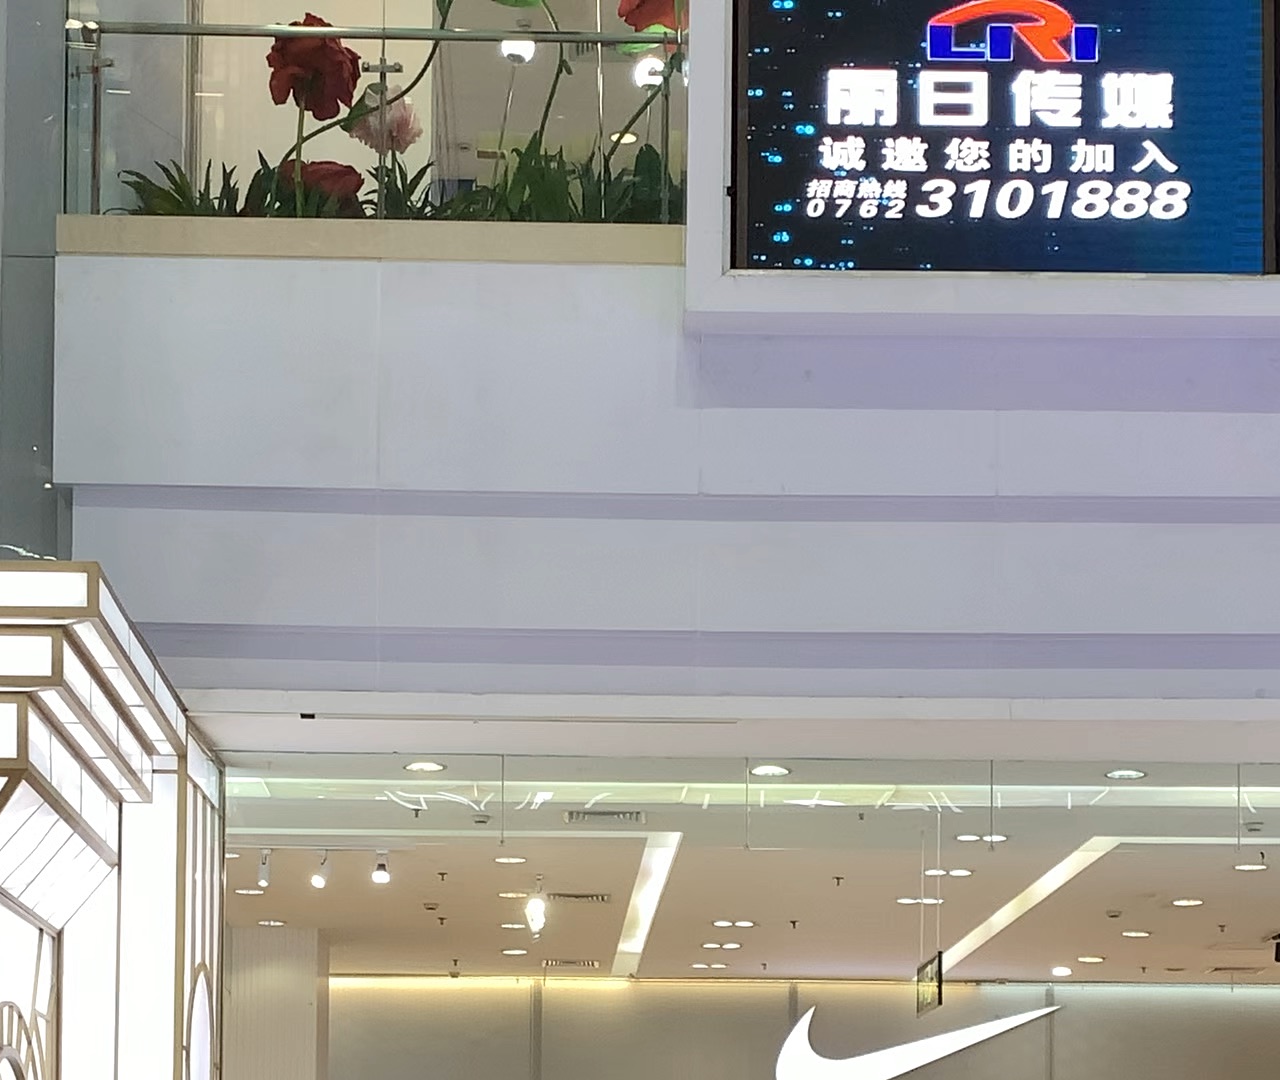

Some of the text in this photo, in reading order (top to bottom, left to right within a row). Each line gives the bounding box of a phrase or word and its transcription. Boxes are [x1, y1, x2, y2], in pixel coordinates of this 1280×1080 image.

[826, 67, 1175, 129] 丽日传媒
[817, 135, 1180, 173] 诚邀您的加入
[805, 178, 908, 199] 招商热线
[806, 178, 1192, 220] 0762 3101888
